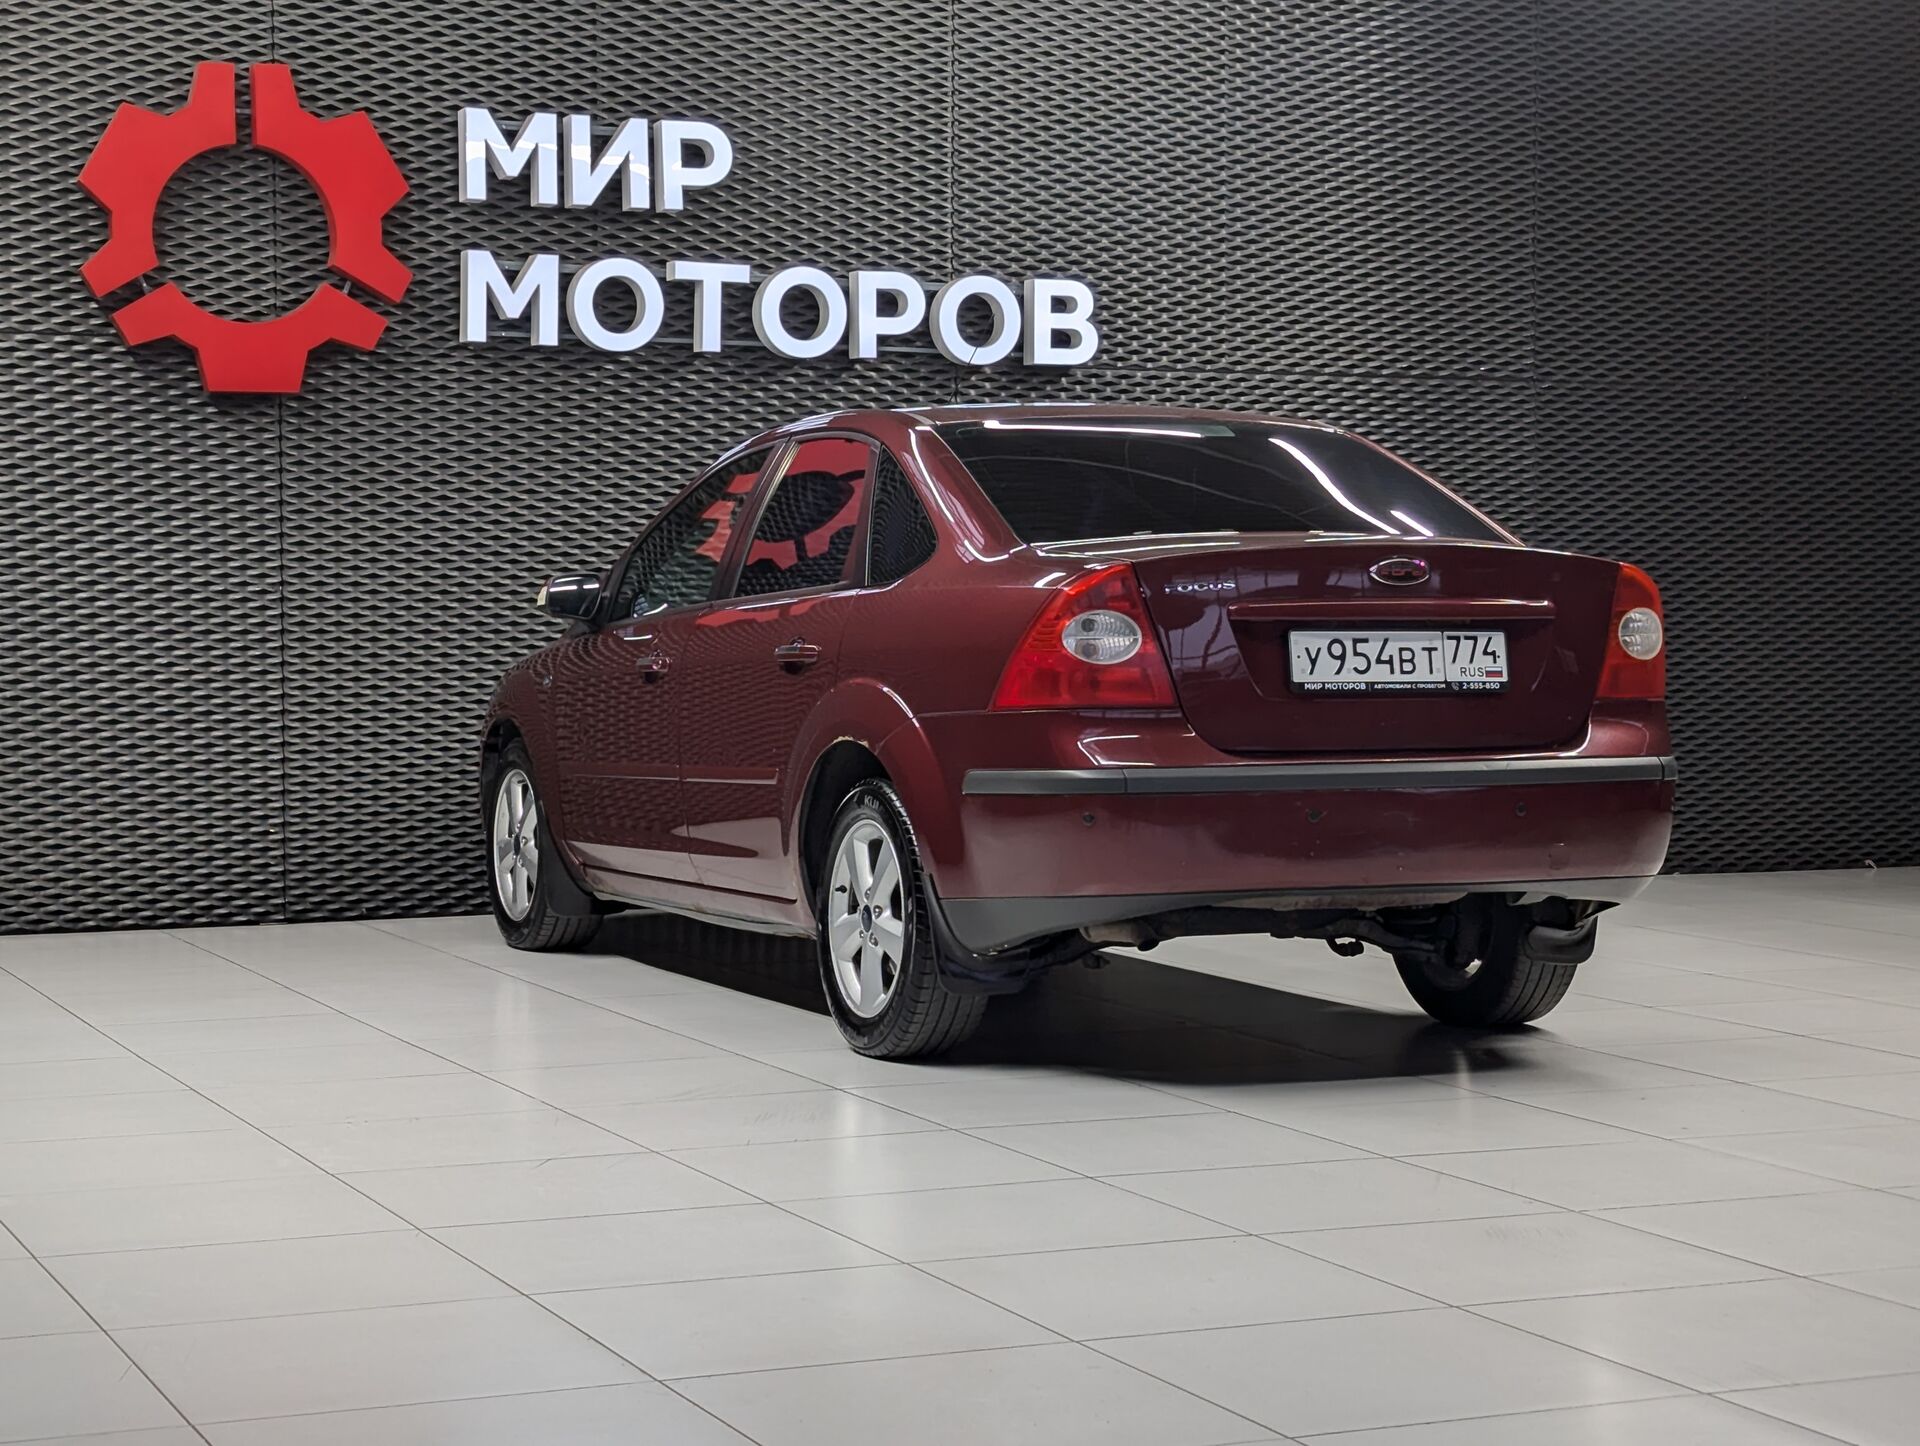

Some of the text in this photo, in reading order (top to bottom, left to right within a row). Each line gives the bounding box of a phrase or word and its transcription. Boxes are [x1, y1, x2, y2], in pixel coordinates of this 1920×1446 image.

[458, 107, 733, 213] МИР
[459, 249, 1100, 368] МОТОРОВ
[1446, 635, 1498, 665] 774
[1304, 682, 1323, 690] МИР
[1325, 682, 1367, 690] МОТОРОВ
[1462, 682, 1500, 690] 2-555-850
[1460, 666, 1485, 678] RUS
